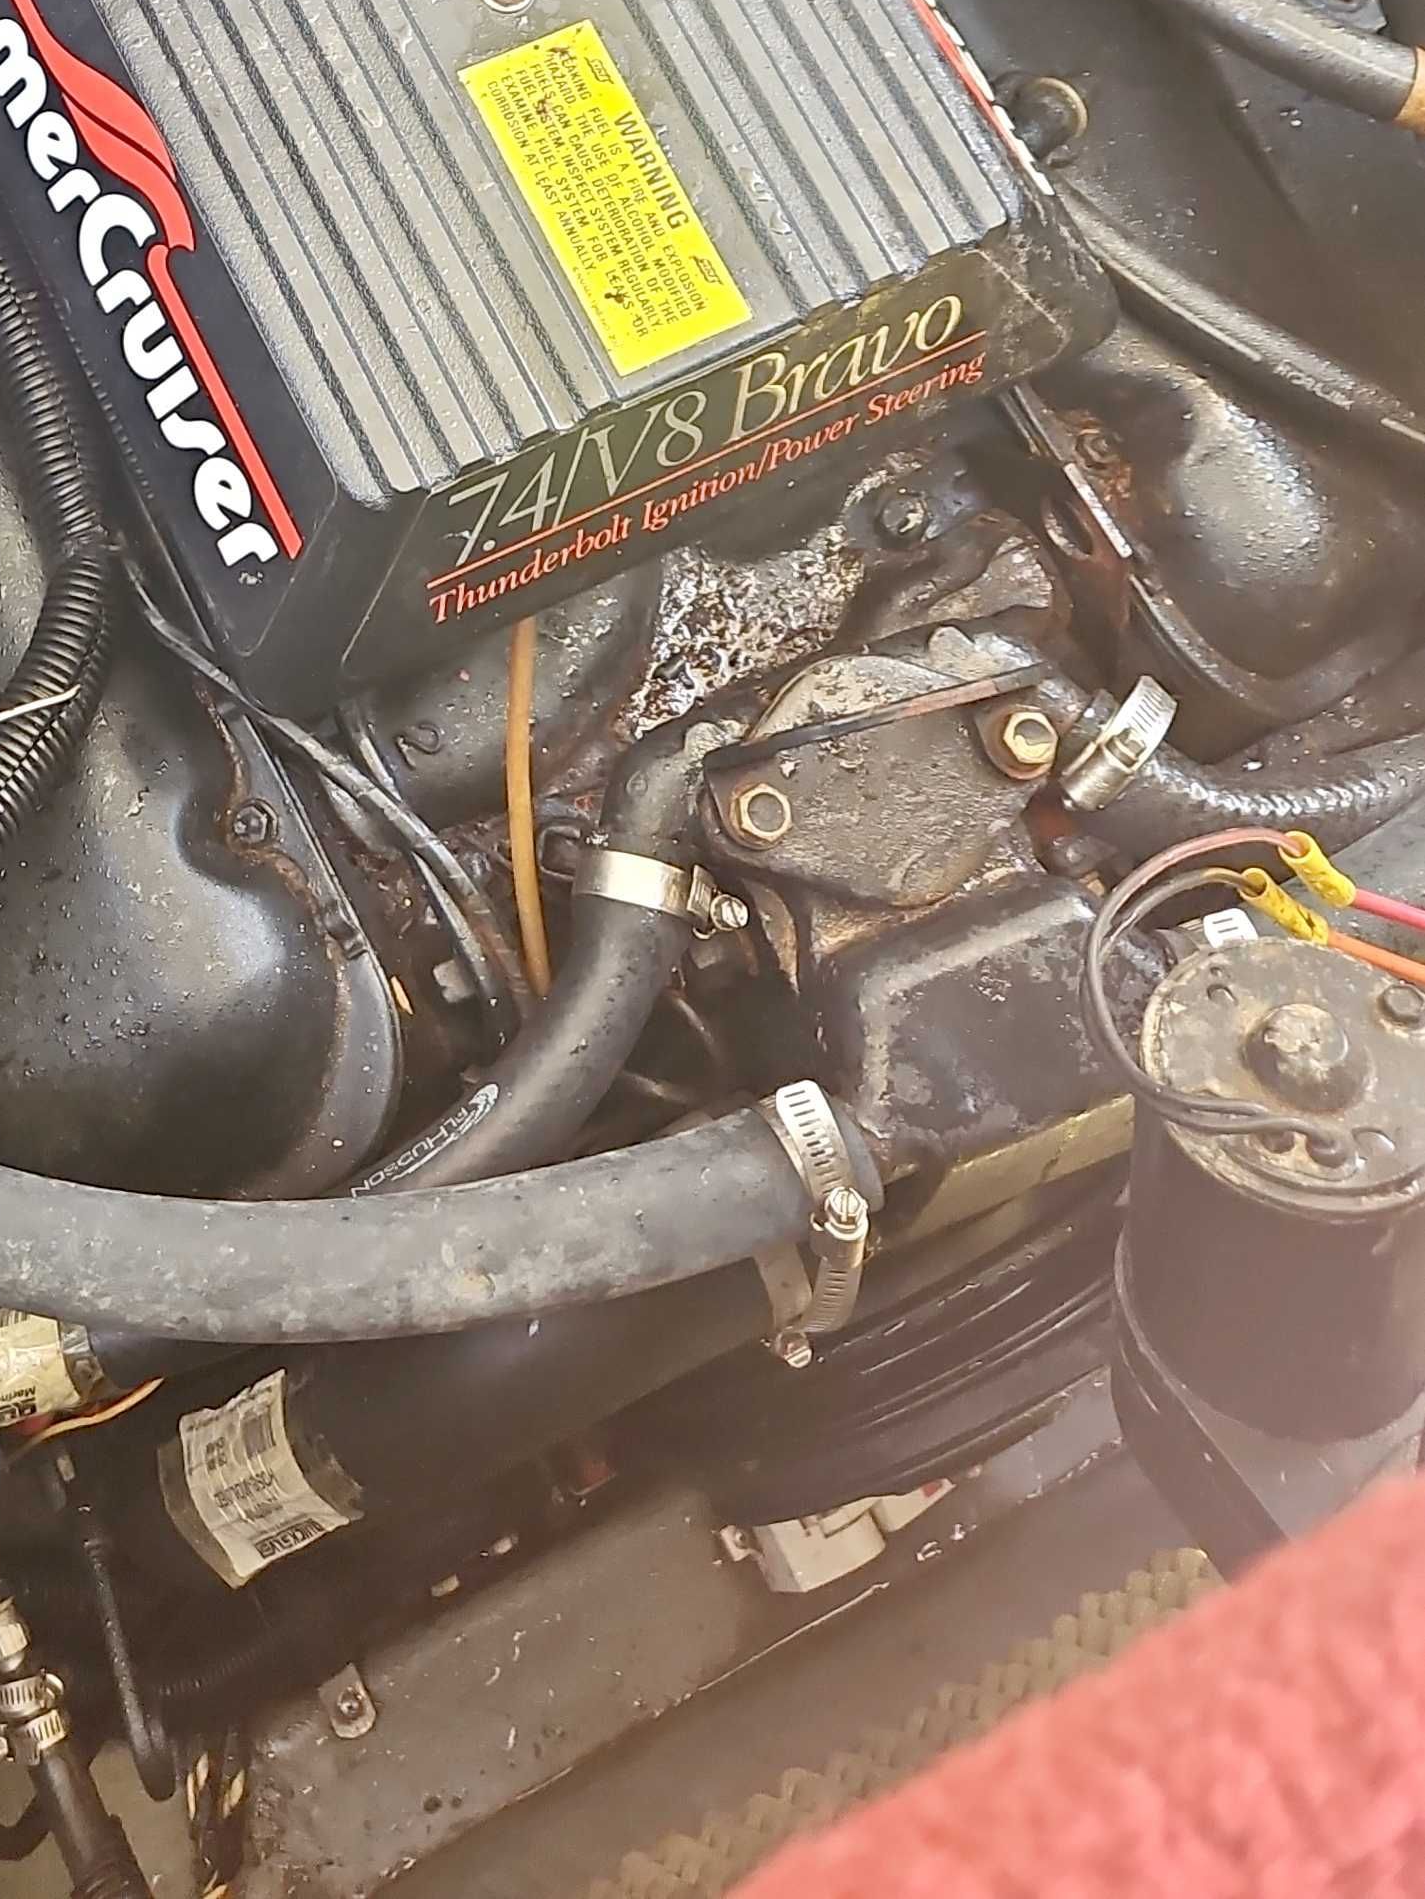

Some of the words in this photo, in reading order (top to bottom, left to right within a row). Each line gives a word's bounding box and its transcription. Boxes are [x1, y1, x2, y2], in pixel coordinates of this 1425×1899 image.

[484, 79, 531, 149] CORROSION
[523, 149, 540, 168] AT
[532, 168, 562, 209] LEAST
[553, 207, 599, 275] ANNUALLY.
[498, 73, 539, 132] EXAMINE
[533, 136, 560, 170] FUEL
[554, 175, 591, 229] SYSTEM
[586, 233, 609, 262] FOR
[603, 267, 636, 311] LEAKS
[628, 313, 650, 338] OR
[514, 67, 538, 98] FUEL
[559, 152, 596, 205] INSPECT
[588, 205, 624, 257] SYSTEM
[615, 256, 665, 332] REGULARLY.
[528, 61, 557, 102] FUELS
[550, 102, 573, 130] CAN
[566, 132, 597, 175] CAUSE
[590, 176, 651, 274] DETERIORATION
[644, 275, 663, 296] OF
[656, 298, 679, 326] THE
[573, 112, 595, 138] THE
[589, 141, 611, 169] USE
[603, 170, 624, 192] OF
[616, 193, 657, 252] ALCOHOL
[650, 255, 693, 319] MODIFIED
[586, 105, 612, 139] FUEL
[606, 141, 622, 158] IS
[616, 159, 631, 173] A
[624, 176, 649, 206] FIRE
[642, 208, 667, 239] AND
[661, 242, 707, 313] EXPLOSION
[611, 110, 691, 232] WARNING
[722, 294, 962, 448] Bravo
[428, 515, 632, 626] Thunderbolt
[641, 413, 862, 534] Ignition/Power
[864, 353, 986, 426] Steering
